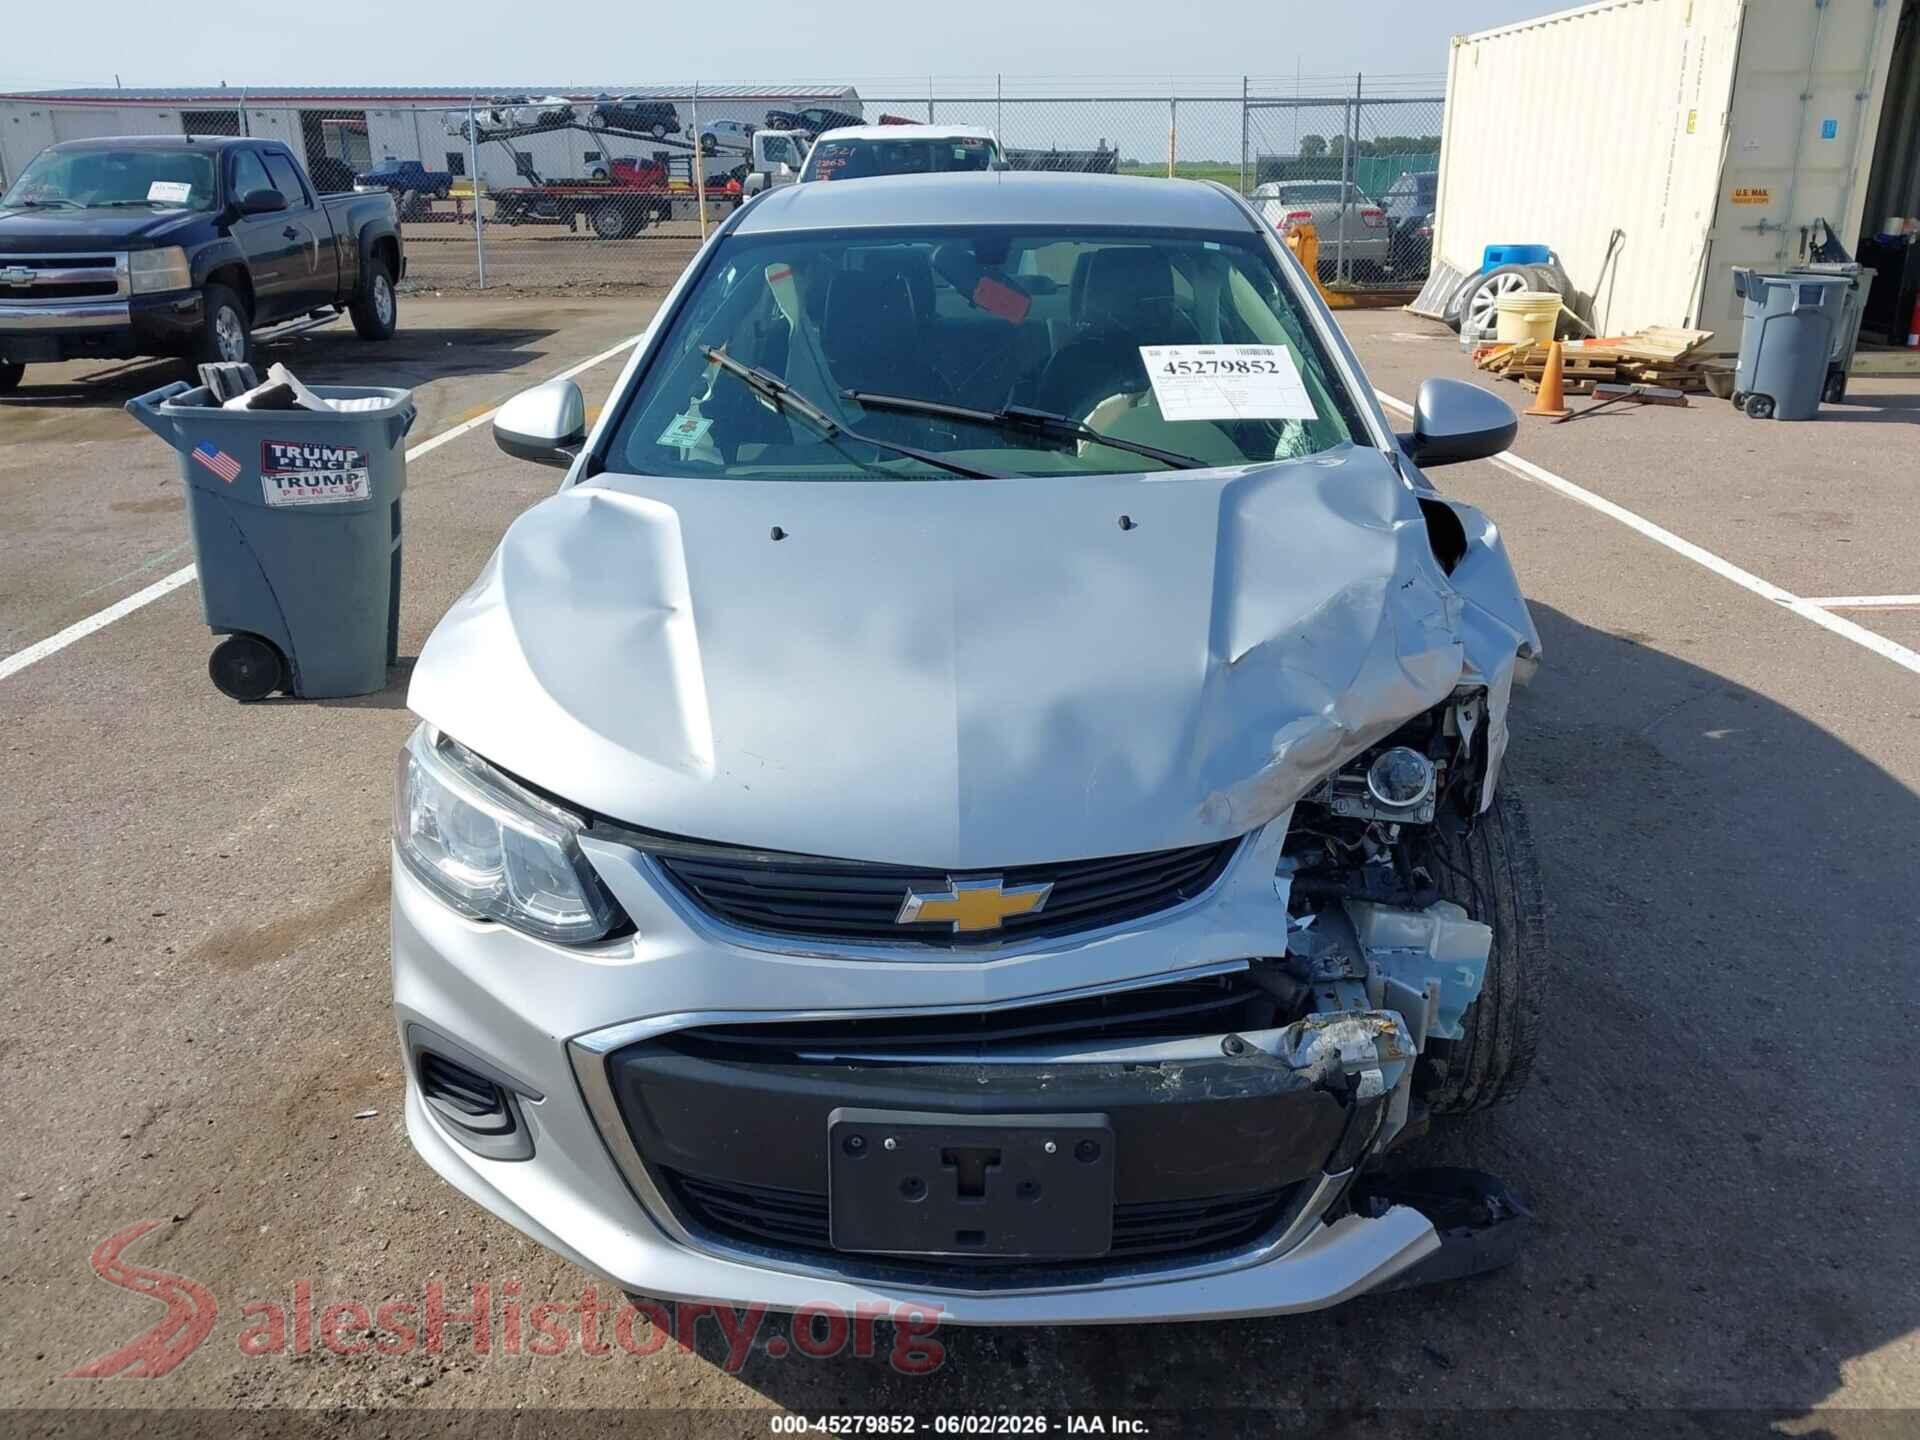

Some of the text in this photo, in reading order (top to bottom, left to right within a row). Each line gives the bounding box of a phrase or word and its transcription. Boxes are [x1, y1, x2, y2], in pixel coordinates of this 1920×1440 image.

[1163, 360, 1280, 375] 45279852
[271, 445, 360, 461] TRUMP
[279, 458, 353, 470] PENCE
[272, 473, 359, 488] TRUMP
